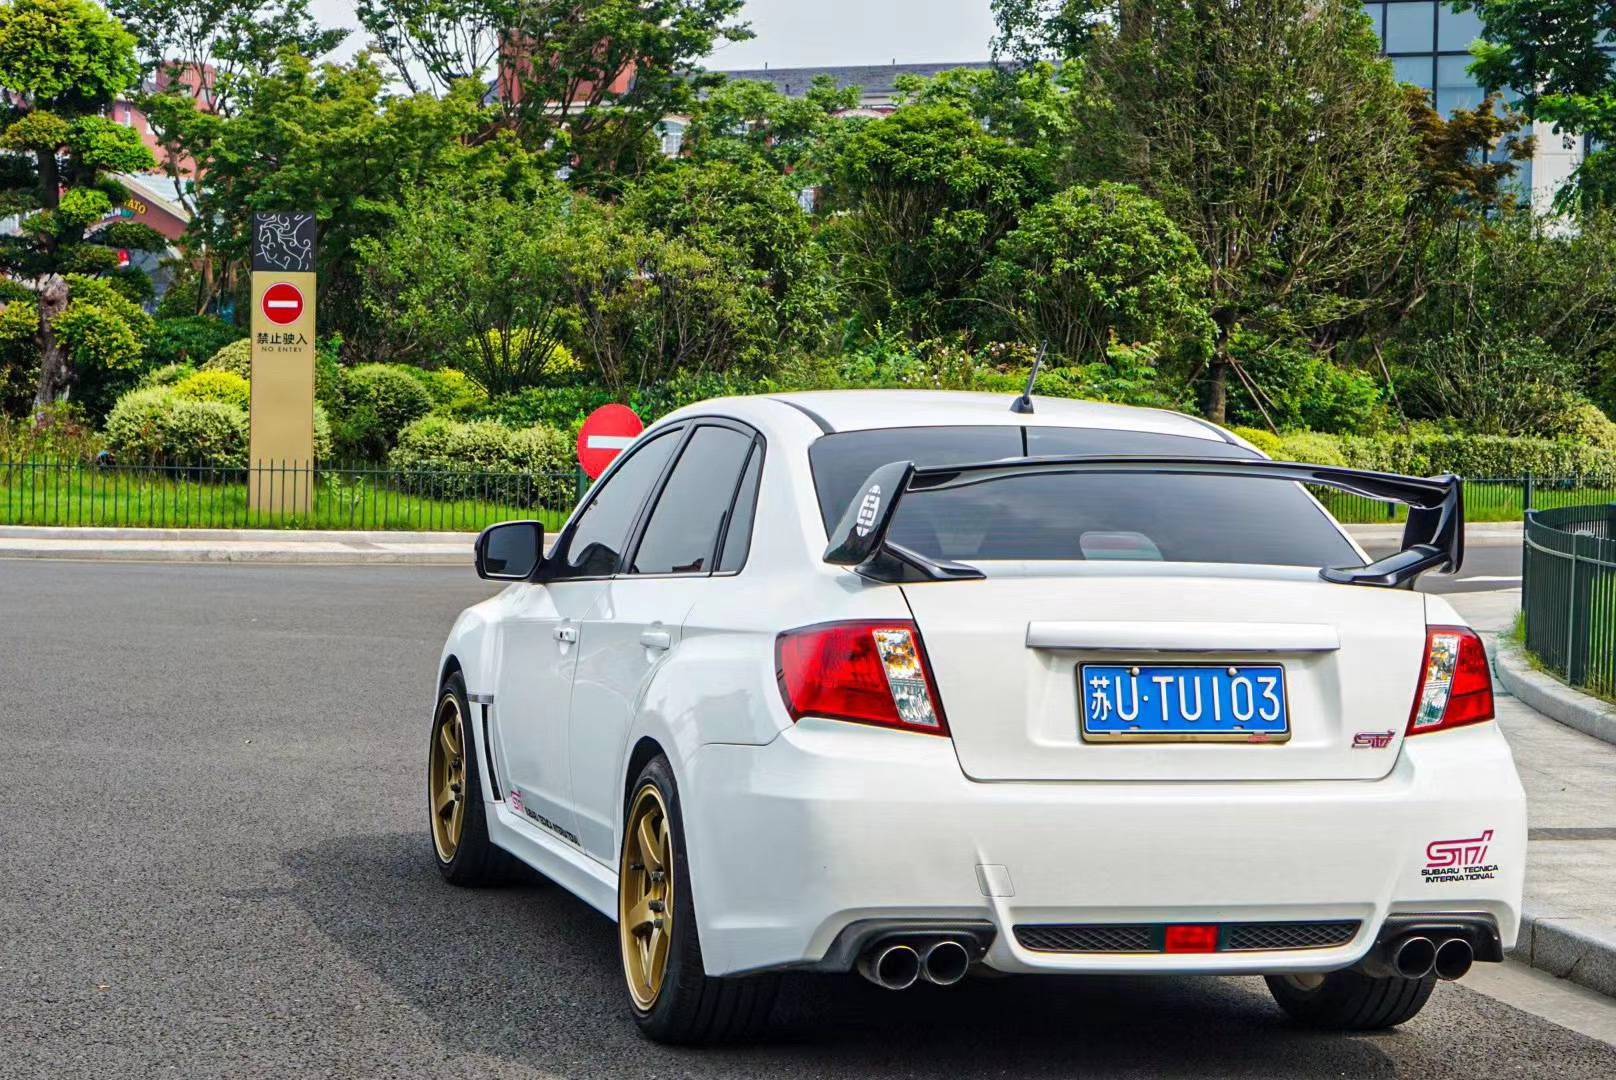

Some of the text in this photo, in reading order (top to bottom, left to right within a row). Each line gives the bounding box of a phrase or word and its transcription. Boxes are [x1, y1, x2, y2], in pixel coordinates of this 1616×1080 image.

[257, 332, 308, 345] 禁止驶入
[1421, 865, 1499, 876] SUBARU TECNICA
[1425, 873, 1495, 883] INTERNATIONAL
